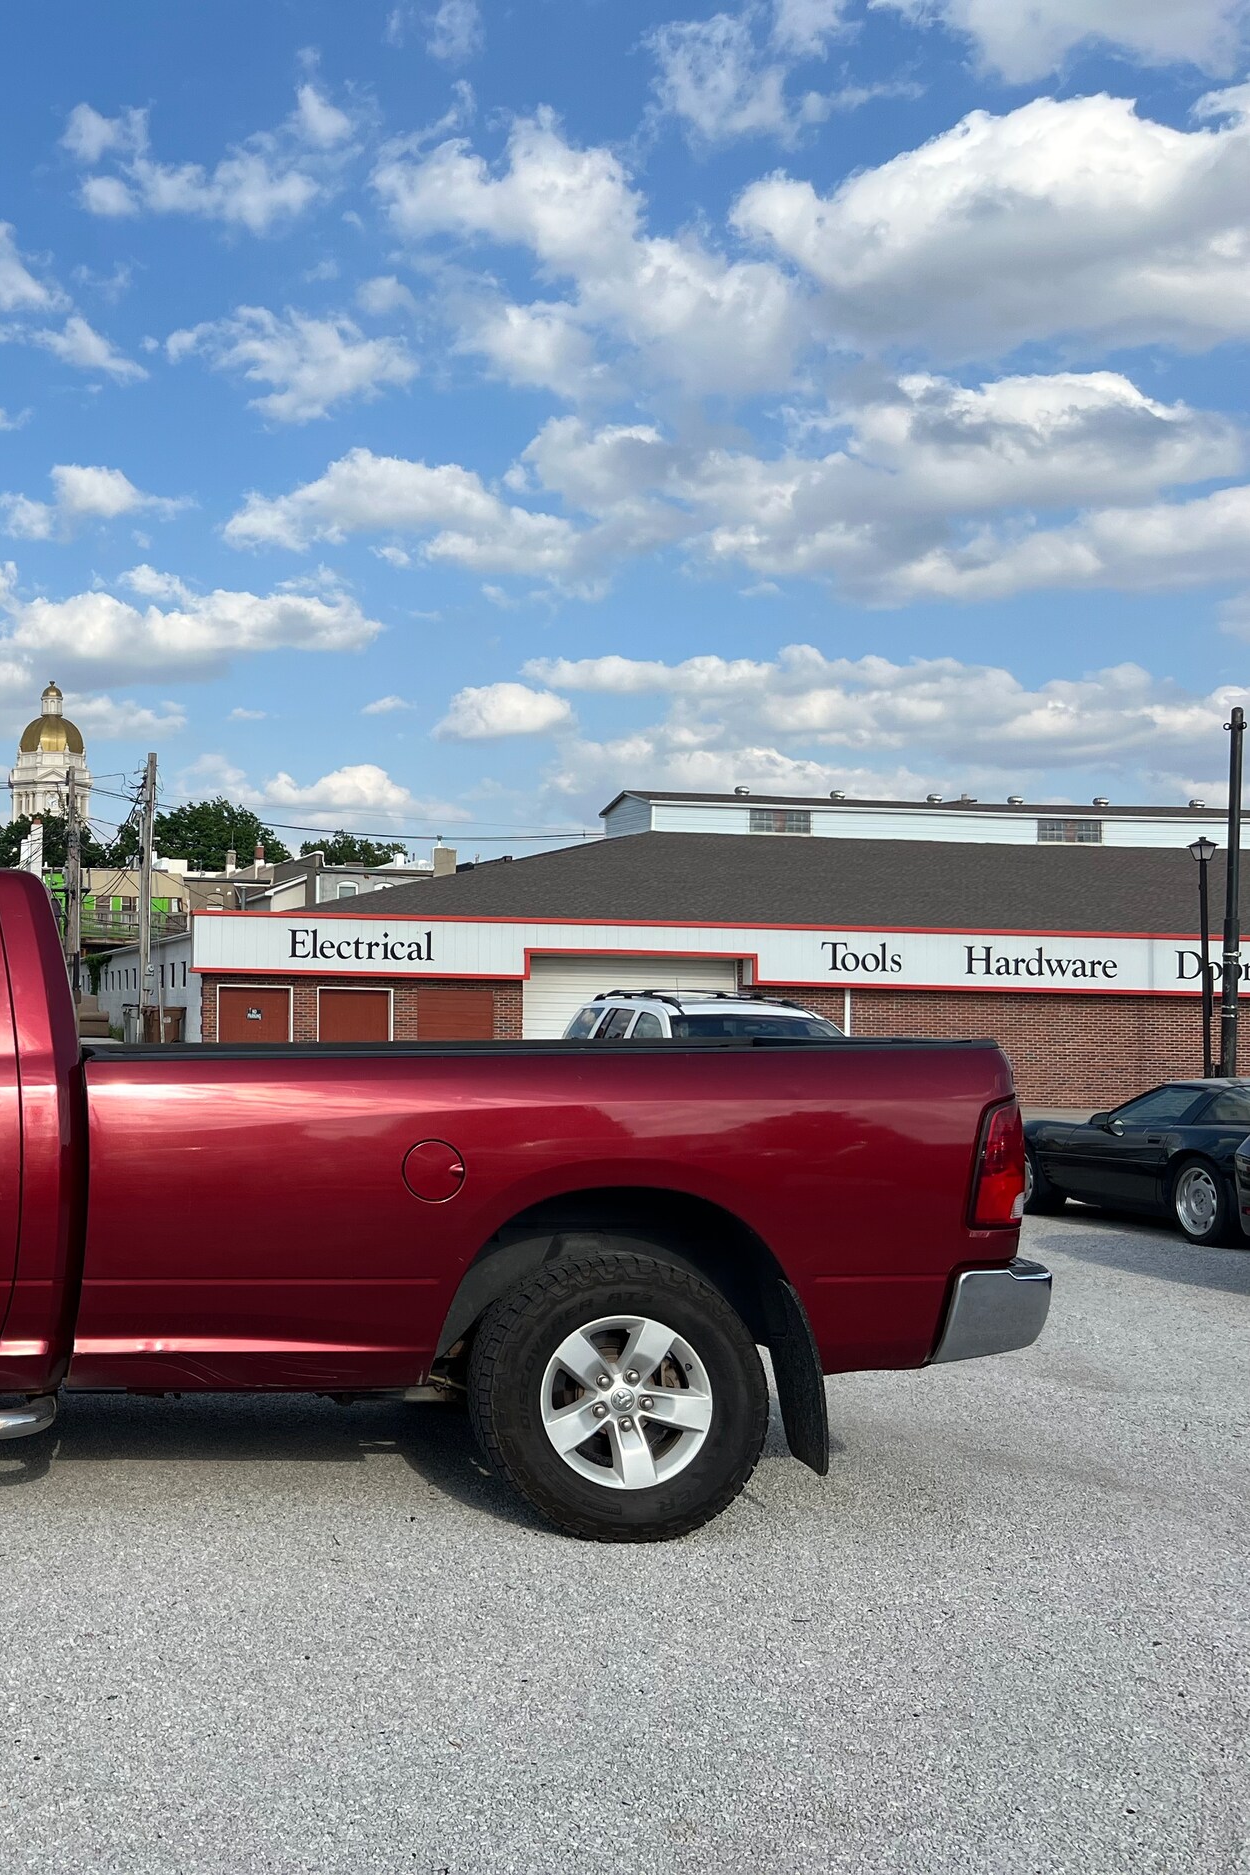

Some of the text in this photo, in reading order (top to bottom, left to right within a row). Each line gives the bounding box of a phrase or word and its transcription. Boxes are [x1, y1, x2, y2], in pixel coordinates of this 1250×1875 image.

[287, 928, 435, 961] Electrical
[821, 941, 902, 973] Tools
[963, 944, 1118, 979] Hardware
[1174, 950, 1250, 980] Dor
